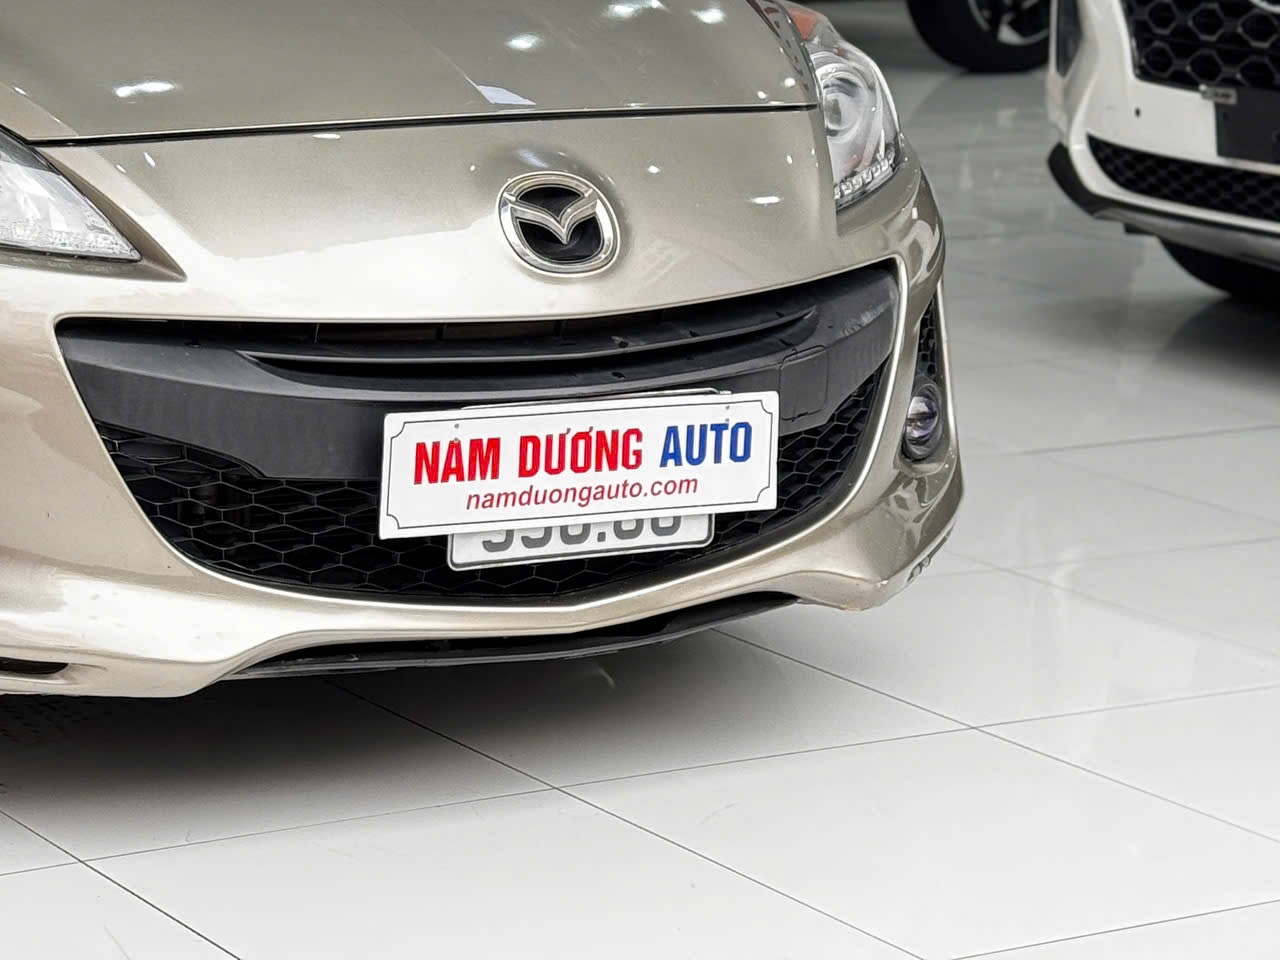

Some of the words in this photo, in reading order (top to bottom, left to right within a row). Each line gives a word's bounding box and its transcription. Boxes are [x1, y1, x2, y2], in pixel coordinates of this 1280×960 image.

[413, 436, 502, 485] NAM
[517, 426, 644, 479] DƯƠNG
[660, 421, 753, 468] AUTO
[466, 477, 698, 510] namduongauto.com
